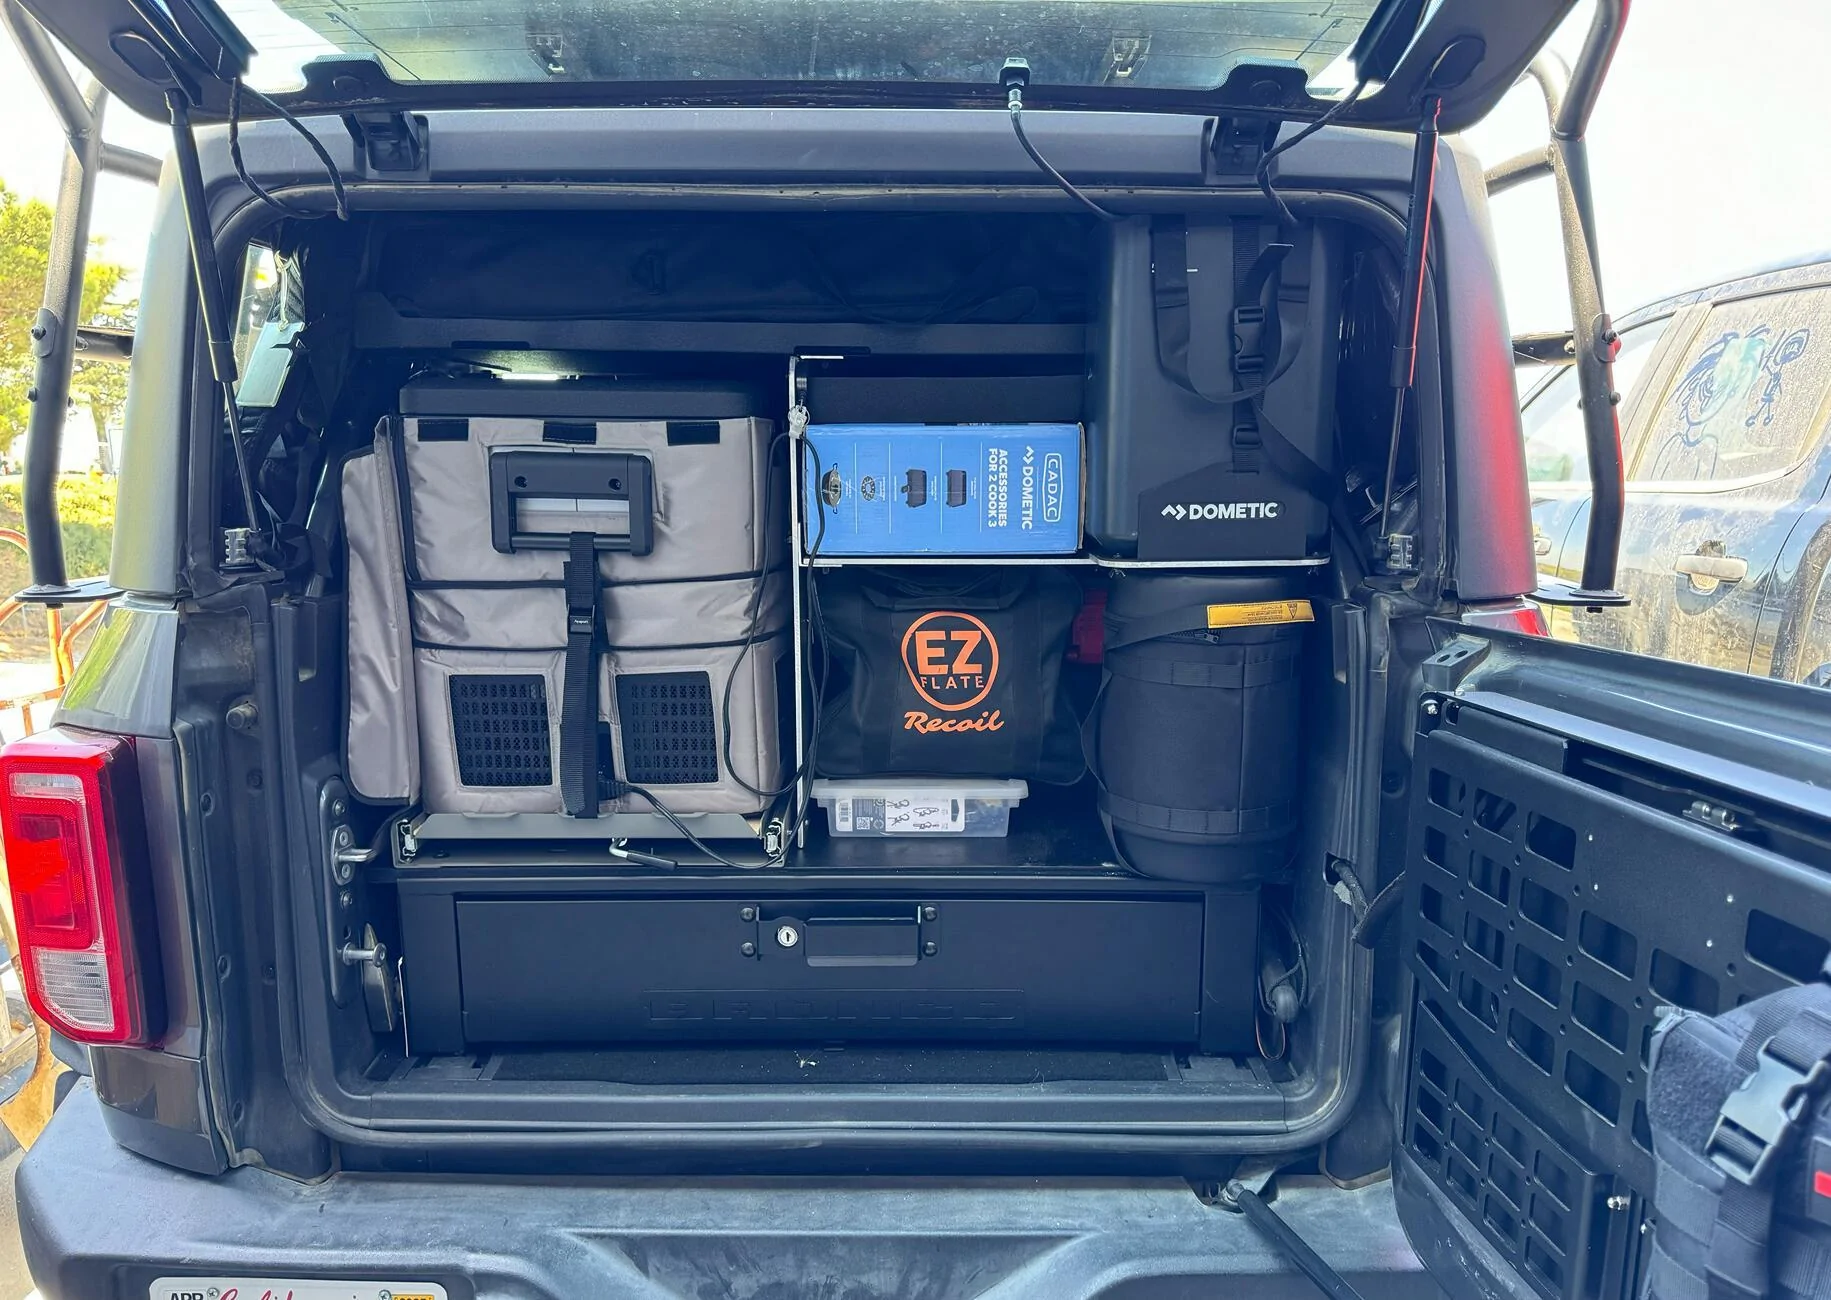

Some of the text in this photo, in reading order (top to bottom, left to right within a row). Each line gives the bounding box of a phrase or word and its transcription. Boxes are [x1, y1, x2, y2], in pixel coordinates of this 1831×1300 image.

[987, 447, 998, 528] FOR 2 COOK 3
[998, 448, 1008, 527] ACCESSORIES
[1021, 466, 1034, 530] DOMETIC
[1047, 458, 1059, 518] CADAC
[1188, 502, 1279, 520] DOMETIC
[914, 630, 983, 675] EZ
[903, 709, 1005, 735] Recoil
